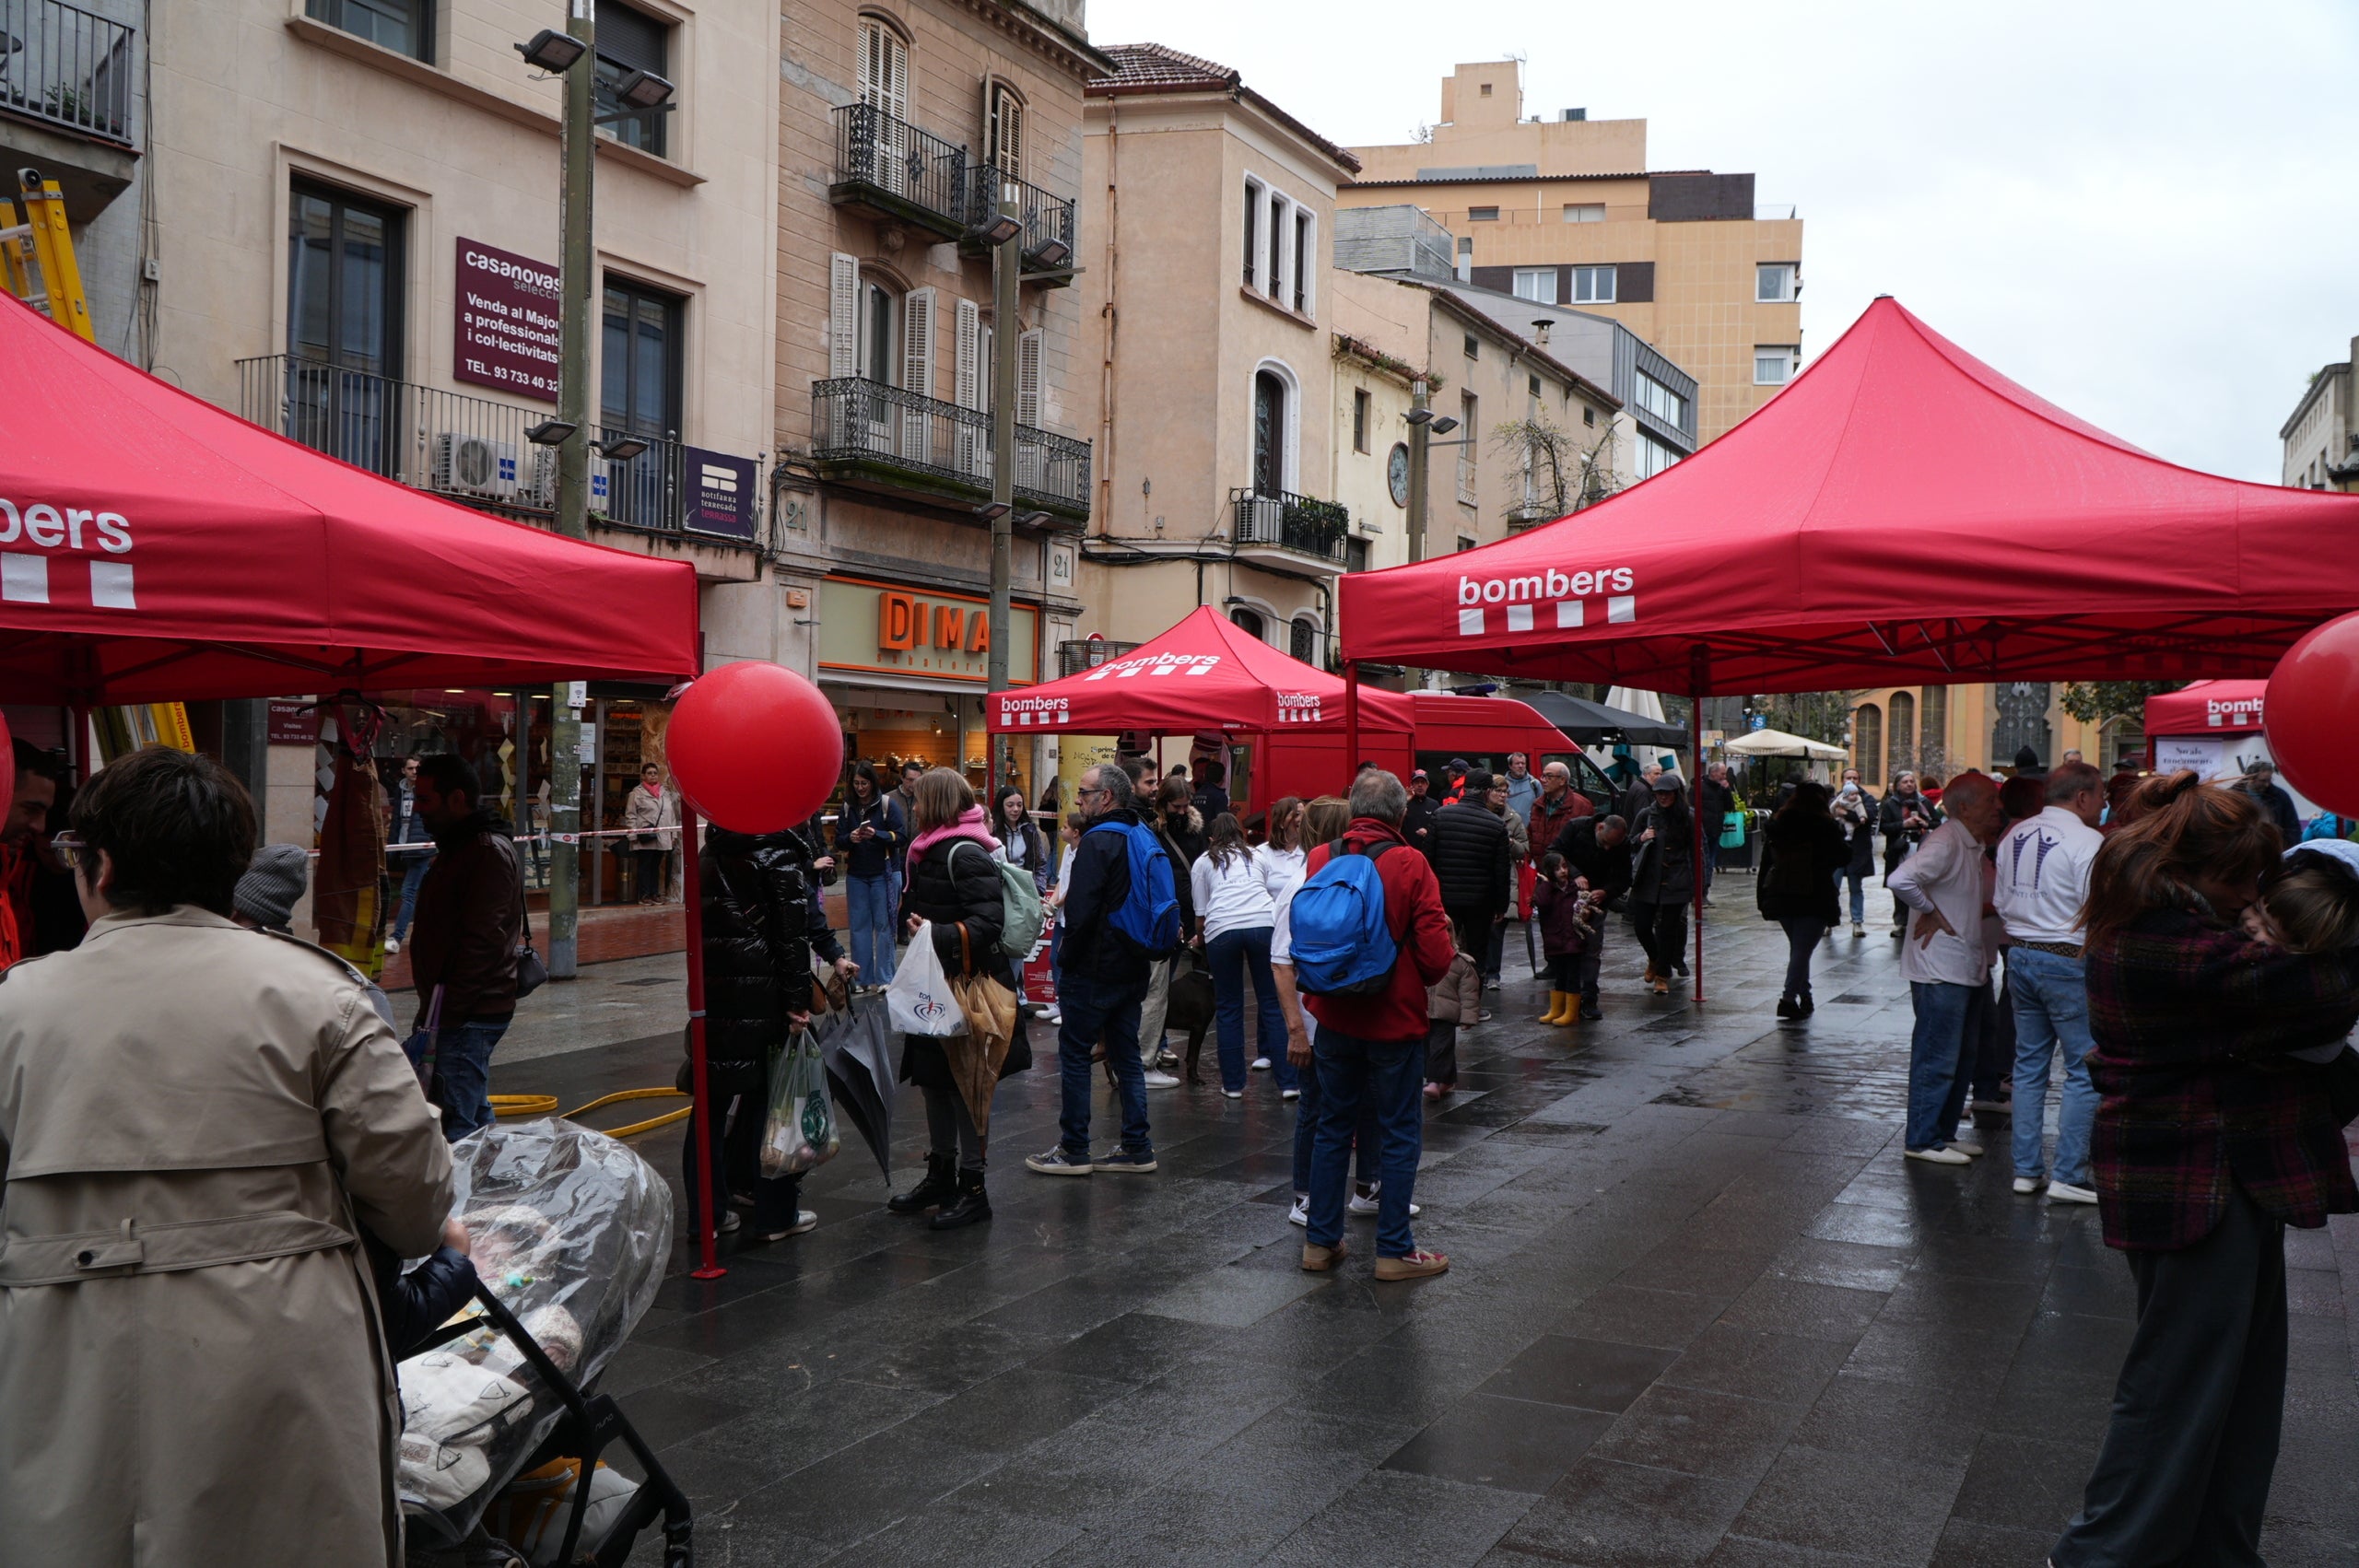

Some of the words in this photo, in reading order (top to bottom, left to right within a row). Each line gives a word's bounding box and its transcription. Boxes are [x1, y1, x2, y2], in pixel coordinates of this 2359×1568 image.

[464, 312, 472, 323] a
[467, 292, 508, 316] Venda
[511, 307, 522, 320] al
[467, 328, 472, 341] i
[465, 358, 491, 376] TEL.
[494, 366, 508, 380] 93
[511, 370, 530, 385] 733
[532, 376, 545, 388] 40
[786, 501, 806, 531] 21
[1054, 553, 1069, 578] 21
[1459, 567, 1635, 605] bombers
[879, 592, 990, 652] DIMA
[1097, 651, 1222, 673] bombers
[1001, 696, 1069, 712] bombers
[1277, 691, 1320, 708] bombers
